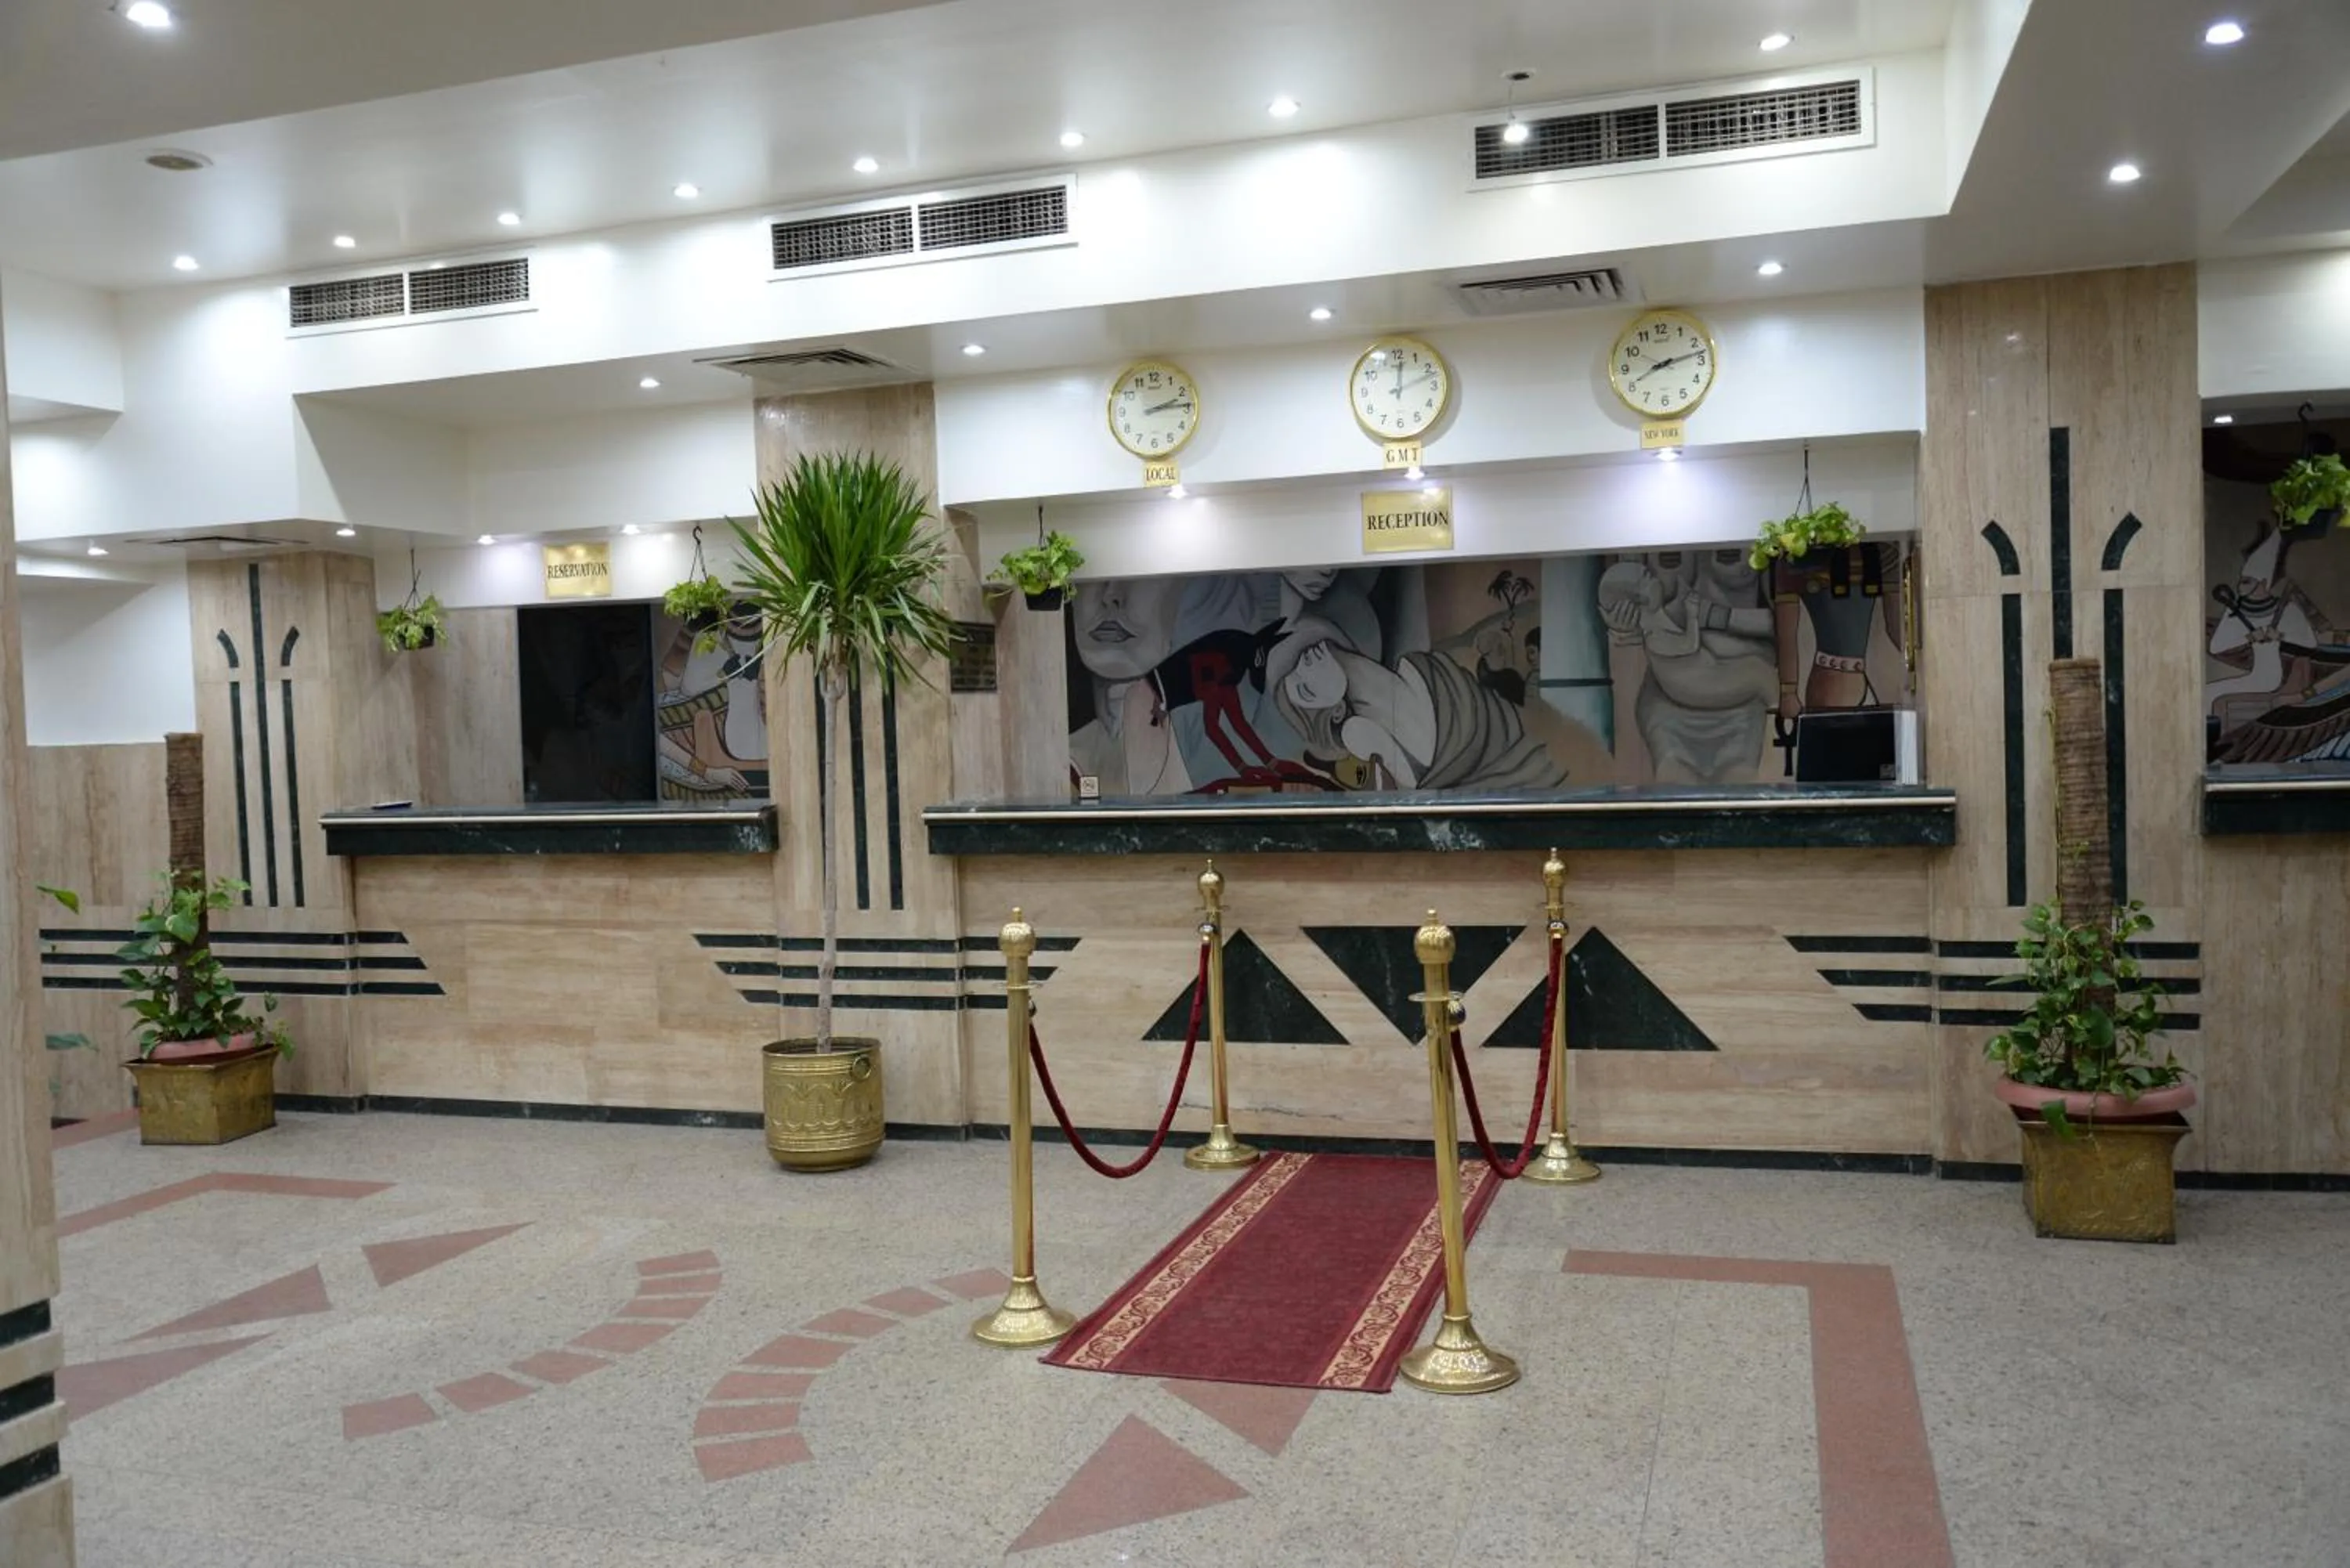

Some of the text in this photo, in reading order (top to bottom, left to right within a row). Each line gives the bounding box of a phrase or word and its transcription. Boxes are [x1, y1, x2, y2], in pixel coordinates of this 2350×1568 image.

[1654, 323, 1667, 334] 12
[1677, 327, 1683, 337] 1
[1638, 331, 1649, 341] 11
[1690, 338, 1698, 348] 2
[1392, 349, 1403, 359] 12
[1625, 346, 1640, 357] 10
[1413, 353, 1417, 363] 1
[1697, 355, 1705, 366] 3
[1425, 363, 1431, 373] 2
[1621, 364, 1629, 374] 9
[1135, 378, 1144, 387] 11
[1148, 373, 1159, 382] 12
[1168, 376, 1173, 385] 1
[1692, 374, 1700, 384] 4
[1179, 386, 1185, 396] 2
[1430, 381, 1437, 391] 3
[1629, 381, 1636, 392] 8
[1123, 392, 1135, 401] 10
[1643, 392, 1650, 403] 7
[1679, 388, 1687, 399] 5
[1426, 399, 1433, 407] 4
[1661, 396, 1669, 406] 6
[1380, 415, 1387, 425] 7
[1397, 419, 1404, 428] 6
[1178, 421, 1184, 430] 4
[1136, 434, 1143, 445] 7
[1167, 433, 1173, 443] 5
[1151, 439, 1159, 448] 6
[1386, 448, 1419, 462] GMT
[1146, 467, 1176, 481] LOCAL
[1367, 511, 1448, 529] RECEPTION
[547, 563, 608, 578] RESERVATION
